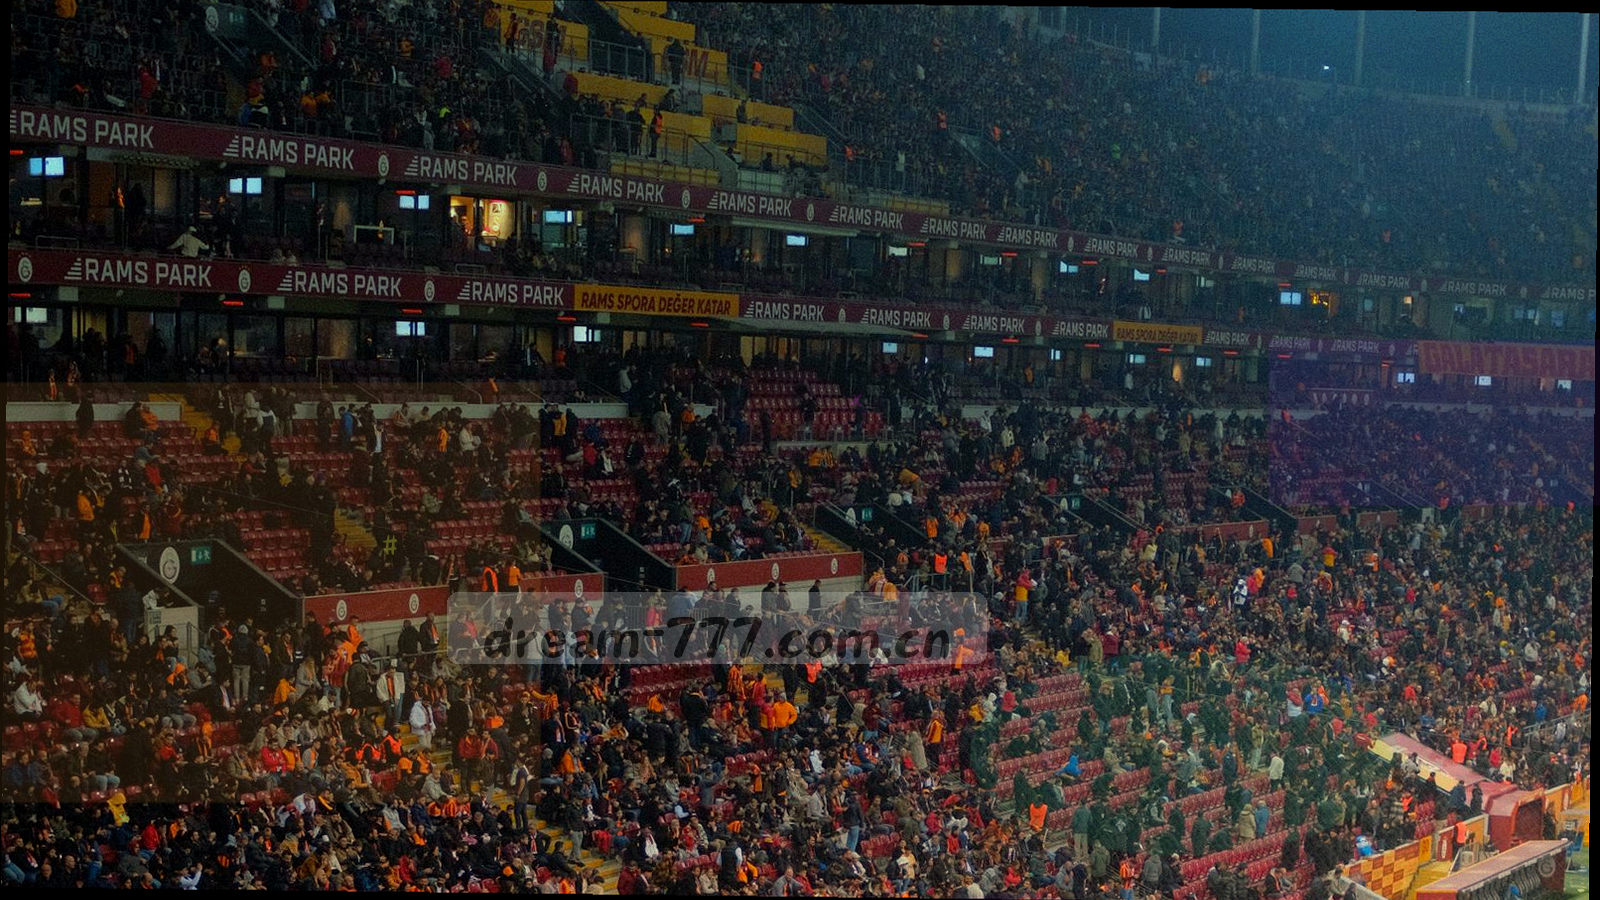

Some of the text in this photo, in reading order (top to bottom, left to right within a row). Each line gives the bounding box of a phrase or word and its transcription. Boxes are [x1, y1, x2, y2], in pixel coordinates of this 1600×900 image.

[20, 111, 154, 149] RAMS PARK
[242, 137, 354, 170] RAMS PARK
[420, 156, 517, 186] RAMS PARK
[580, 174, 664, 204] RAMS PARK
[718, 191, 792, 218] RAMS PARK
[839, 205, 903, 230] RAMS PARK
[928, 218, 987, 240] RAMS PARK
[1005, 227, 1058, 248] RAMS PARK
[1092, 238, 1139, 258] RAMS PARK
[1169, 248, 1210, 267] RAMS PARK
[85, 258, 212, 288] RAMS PARK
[1363, 273, 1410, 289] RAMS PARK
[295, 271, 401, 299] RAMS PARK
[473, 281, 564, 306] RAMS PARK
[1448, 281, 1507, 296] RAMS PARK
[1551, 287, 1585, 300] RAMS
[581, 292, 732, 316] RAMS SPORA DEĞER KATAR
[754, 302, 825, 322] RAMS PARK
[868, 309, 931, 328] RAMS PARK
[971, 315, 1025, 333] RAMS PARK
[1060, 321, 1109, 338] RAMS PARK
[1210, 331, 1250, 346] RAMS PARK
[1273, 336, 1311, 350] RAMS PARK
[1336, 339, 1380, 353] RAMS PARK
